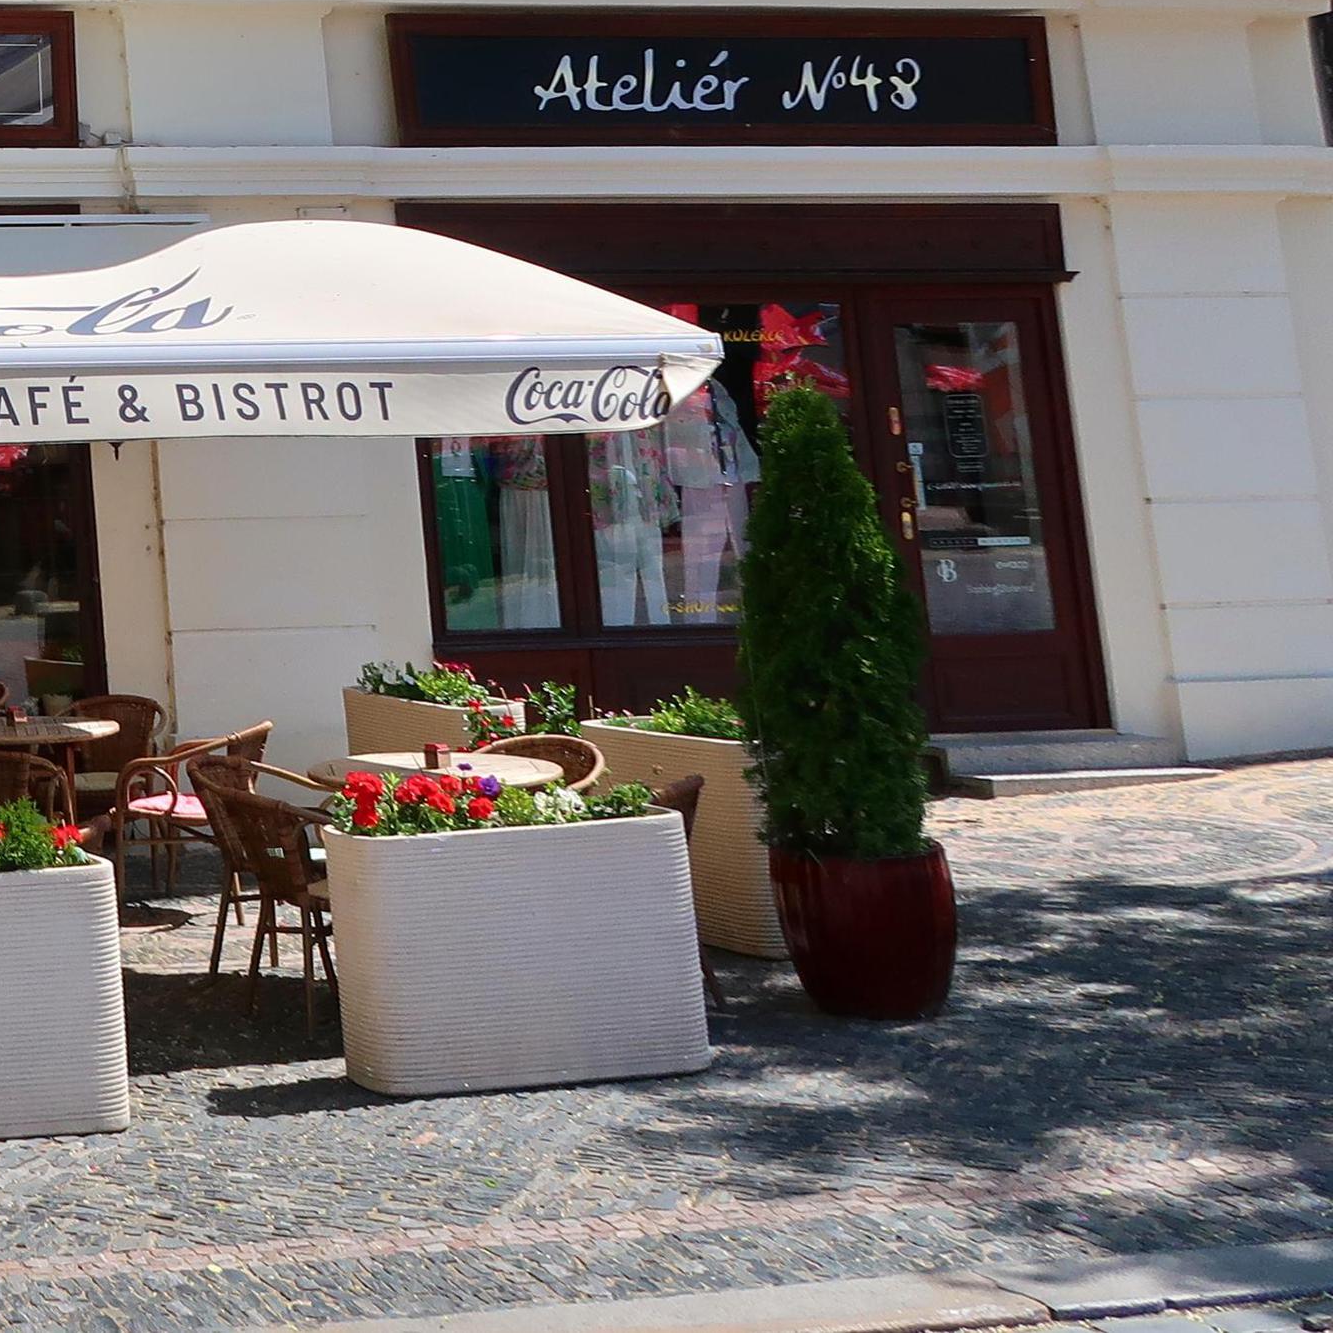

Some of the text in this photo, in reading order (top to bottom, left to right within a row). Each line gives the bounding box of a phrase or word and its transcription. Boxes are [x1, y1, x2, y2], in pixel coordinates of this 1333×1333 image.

[533, 47, 750, 113] Ateliér
[116, 383, 151, 424] &
[174, 380, 394, 422] BISTROT
